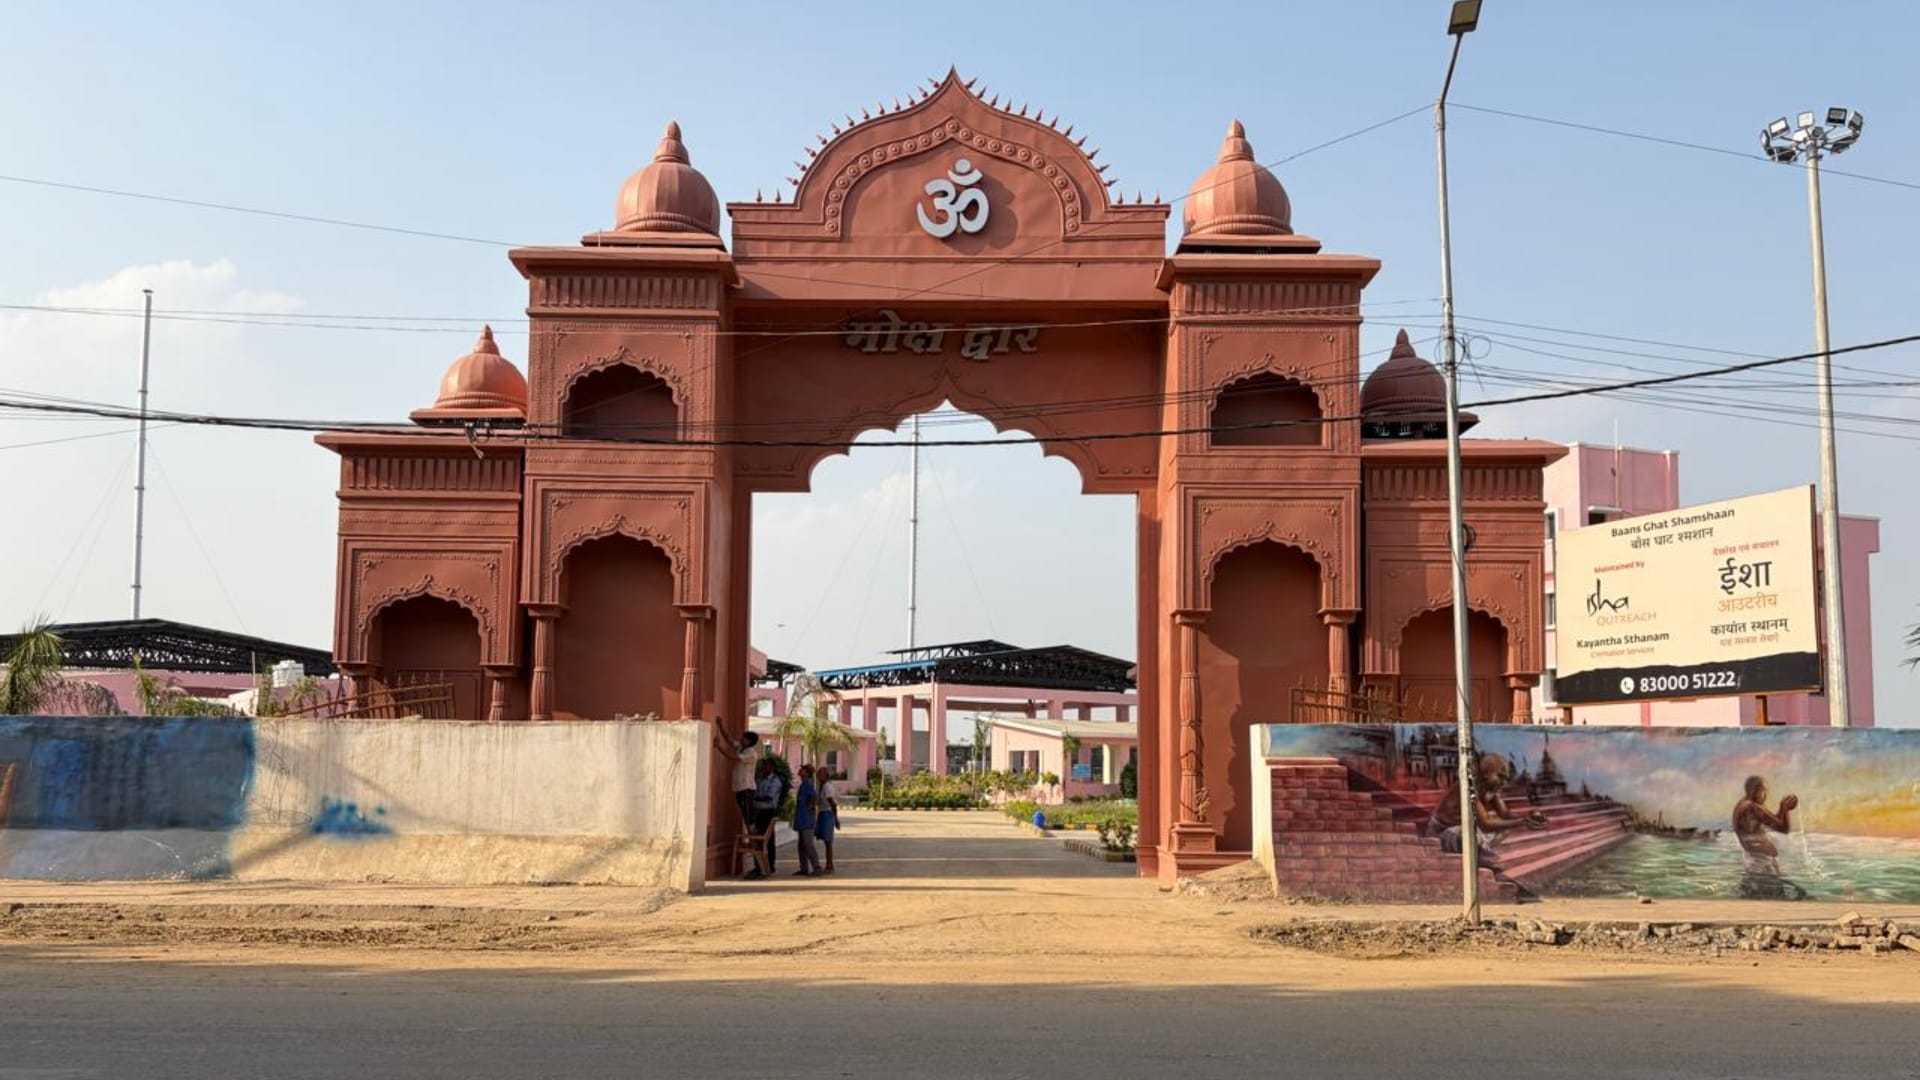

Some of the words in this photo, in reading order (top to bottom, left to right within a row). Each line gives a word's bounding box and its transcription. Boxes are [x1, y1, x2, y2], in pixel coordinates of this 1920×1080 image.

[845, 309, 952, 353] मोक्ष
[960, 321, 1040, 360] द्वार
[1611, 525, 1641, 537] Baans
[1643, 520, 1669, 532] Ghat
[1671, 509, 1735, 527] Shamshaan
[1718, 557, 1772, 595] ईशा
[1718, 592, 1777, 612] आउटरीच
[1596, 612, 1657, 626] OUTREACH
[1750, 618, 1791, 632] स्थानम्
[1576, 636, 1622, 649] Kayantha
[1624, 632, 1670, 644] Sthanam
[1640, 675, 1689, 693] 83000
[1692, 671, 1736, 689] 51222
